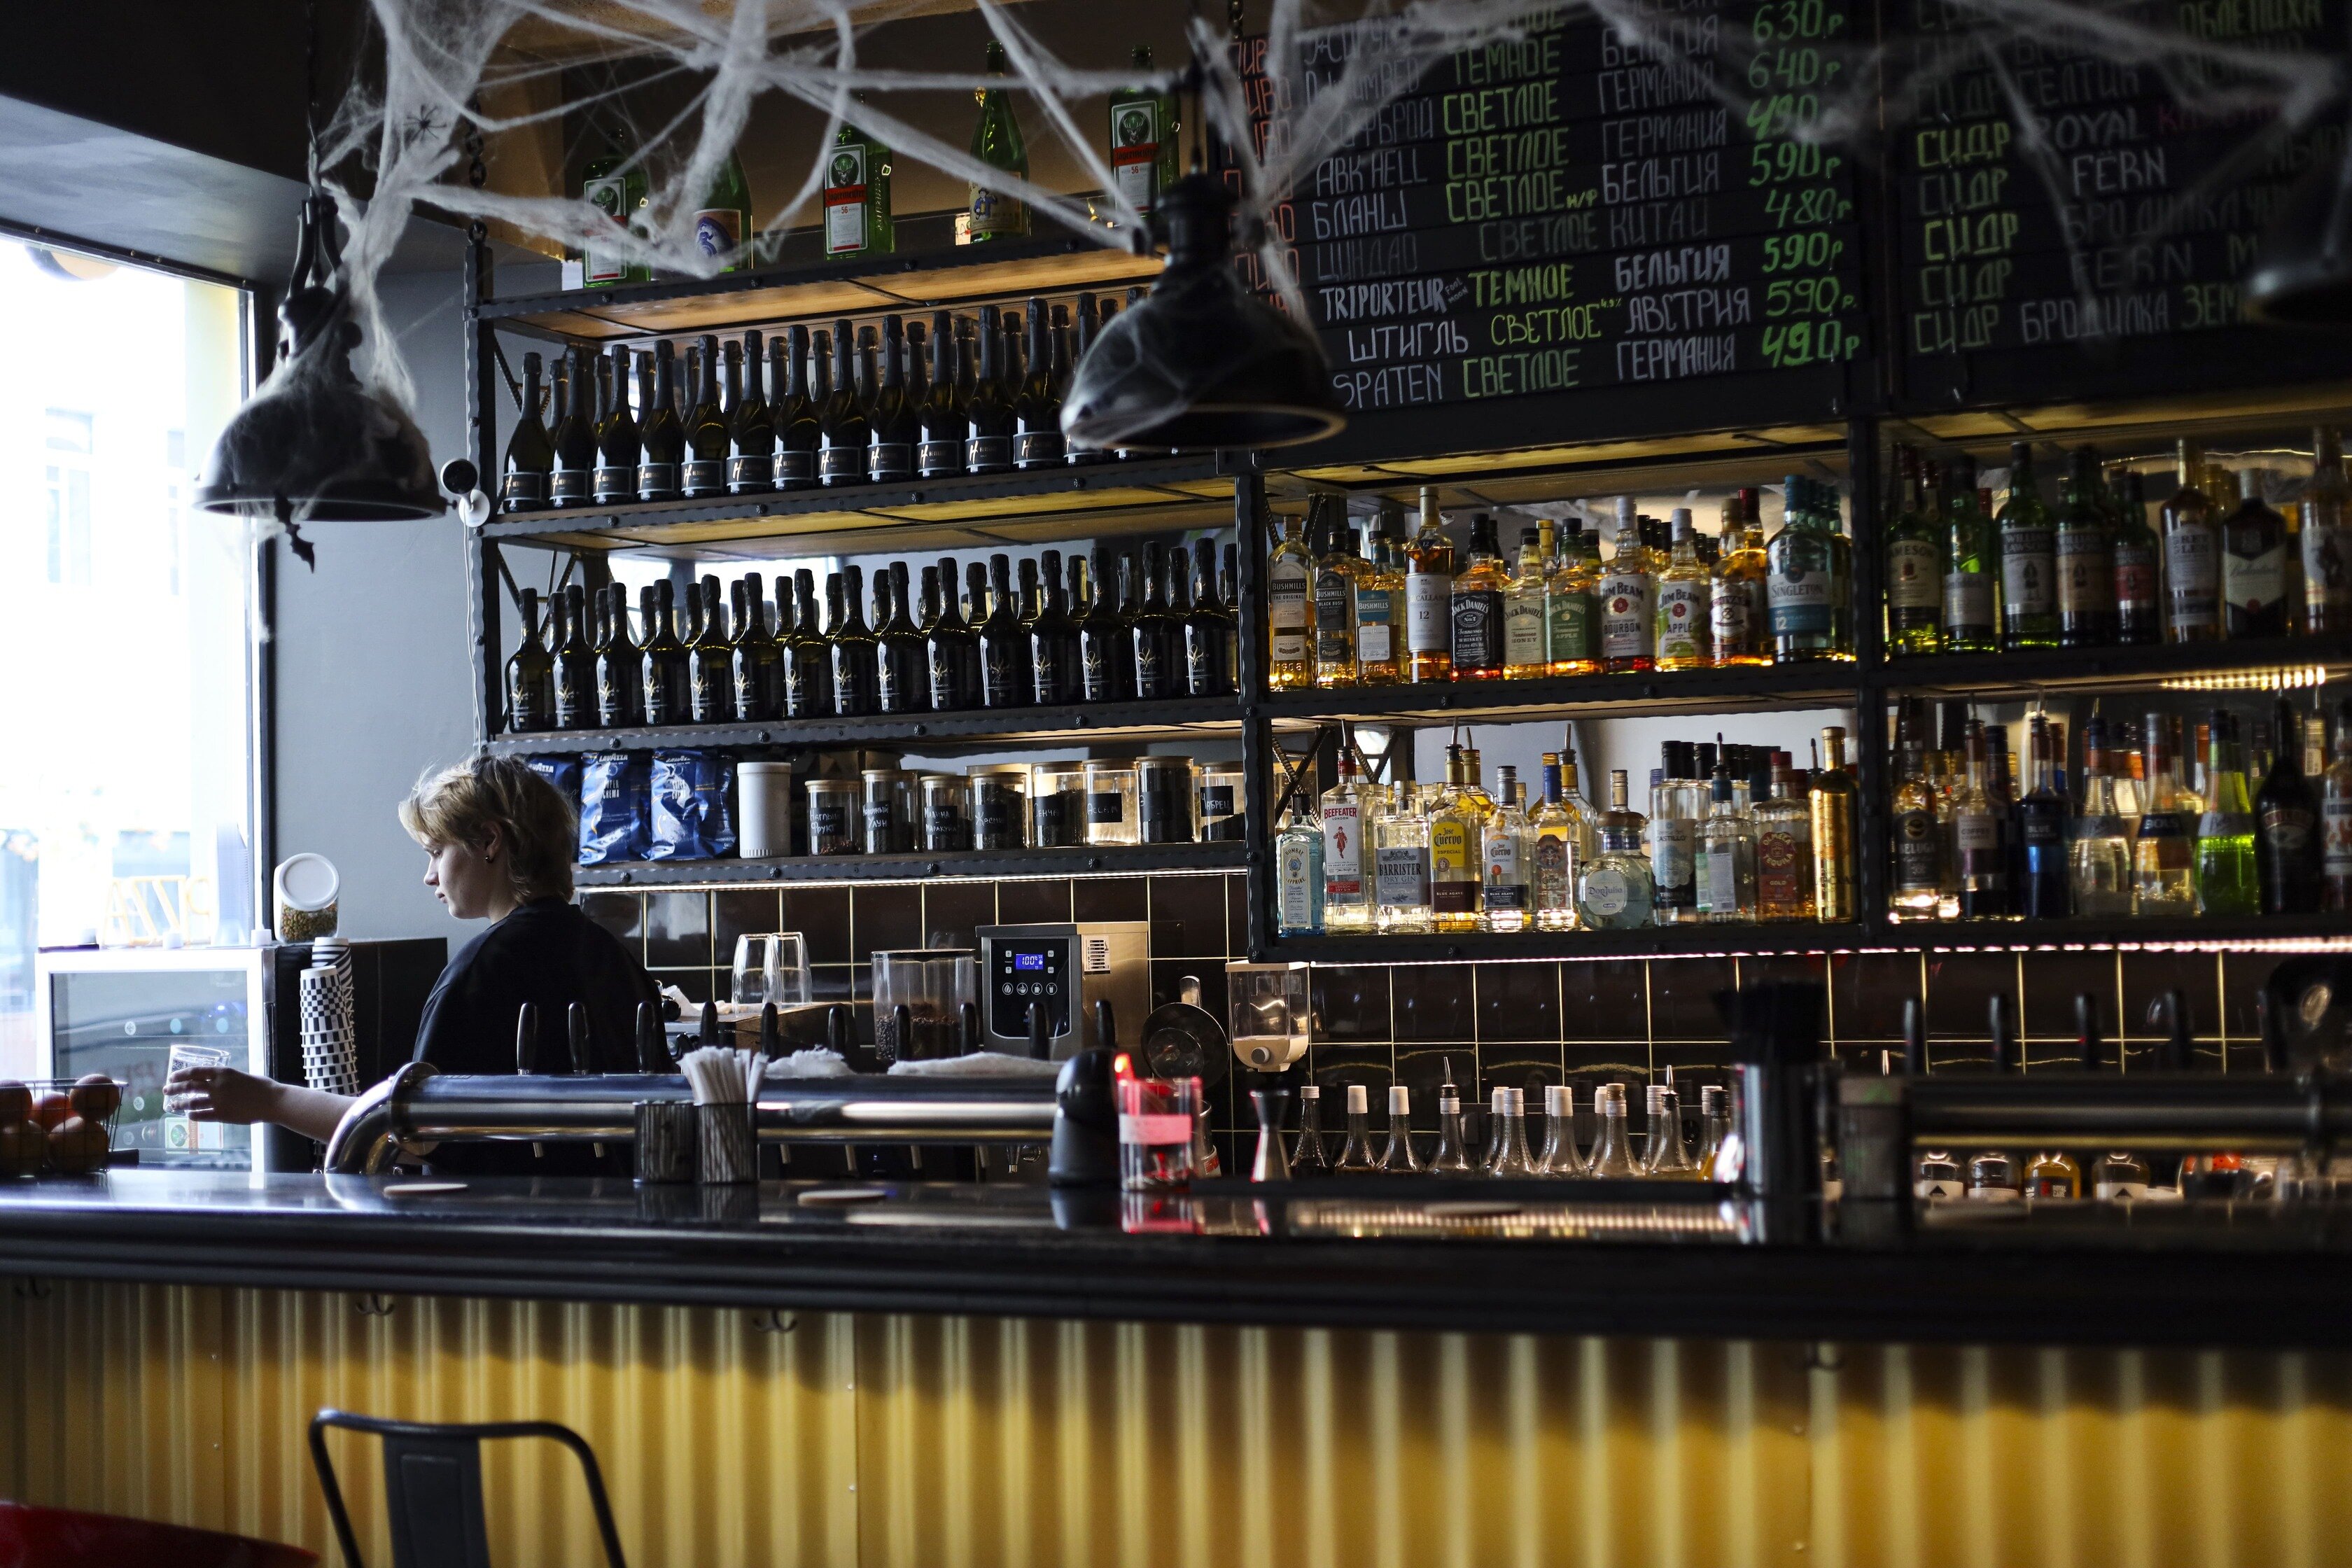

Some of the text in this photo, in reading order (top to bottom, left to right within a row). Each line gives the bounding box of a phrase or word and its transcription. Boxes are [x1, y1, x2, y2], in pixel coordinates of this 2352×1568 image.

[1245, 76, 1292, 116] ИВО
[1443, 79, 1561, 136] СВЕТЛОЕ
[1598, 59, 1715, 114] ГЕРМАНИЯ
[1446, 127, 1570, 180] СВЕТЛОЕ
[1602, 108, 1727, 162] ГЕРМАНИЯ
[1917, 120, 2011, 168] СИДР
[1130, 166, 1139, 174] 56
[1311, 189, 1408, 240] БЛАНШ
[1445, 169, 1565, 223] СВЕТЛОЕ
[1602, 150, 1720, 204] БЕЛЬГИЯ
[1919, 166, 2010, 216] СИДР
[841, 206, 848, 214] 56
[1924, 211, 2019, 262] СИДР
[1315, 232, 1418, 281] ЦИНДАО
[1478, 211, 1598, 262] СВЕТЛОЕ
[1467, 262, 1576, 308] ТЕМНОЕ
[1615, 244, 1731, 293] БЕЛЬГИЯ
[1919, 258, 2014, 307] СИДР
[1319, 276, 1448, 322] TRIPORTEUR
[1348, 320, 1469, 363] ШТИГЛЬ
[1490, 303, 1602, 346] СВЕТЛОЕ
[1624, 288, 1751, 334] АВСТРИЯ
[1914, 288, 2169, 356] СИДР БРОДИЛКА
[1332, 332, 1736, 409] SPATEN СВЕТЛОЕ ГЕРМАНИЯ
[1272, 582, 1306, 591] BUSHMILLS
[1601, 582, 1644, 603] JIM BEAM
[1771, 584, 1823, 598] SINGLETON
[1660, 589, 1700, 608] JIM BEAM
[1464, 599, 1490, 614] DANIEL'S
[1519, 605, 1543, 620] DANIEL'S
[1419, 611, 1430, 620] 12
[1604, 622, 1641, 634] BOURBON
[1667, 622, 1693, 634] APPLE
[1774, 616, 1787, 631] 12
[598, 752, 628, 762] LAVAZZA
[1324, 807, 1357, 819] BEEFEATER
[1442, 827, 1454, 836] Jose
[1434, 832, 1462, 847] Cuervo
[1490, 846, 1511, 858] Cuervo
[1379, 863, 1422, 876] BARRISTER
